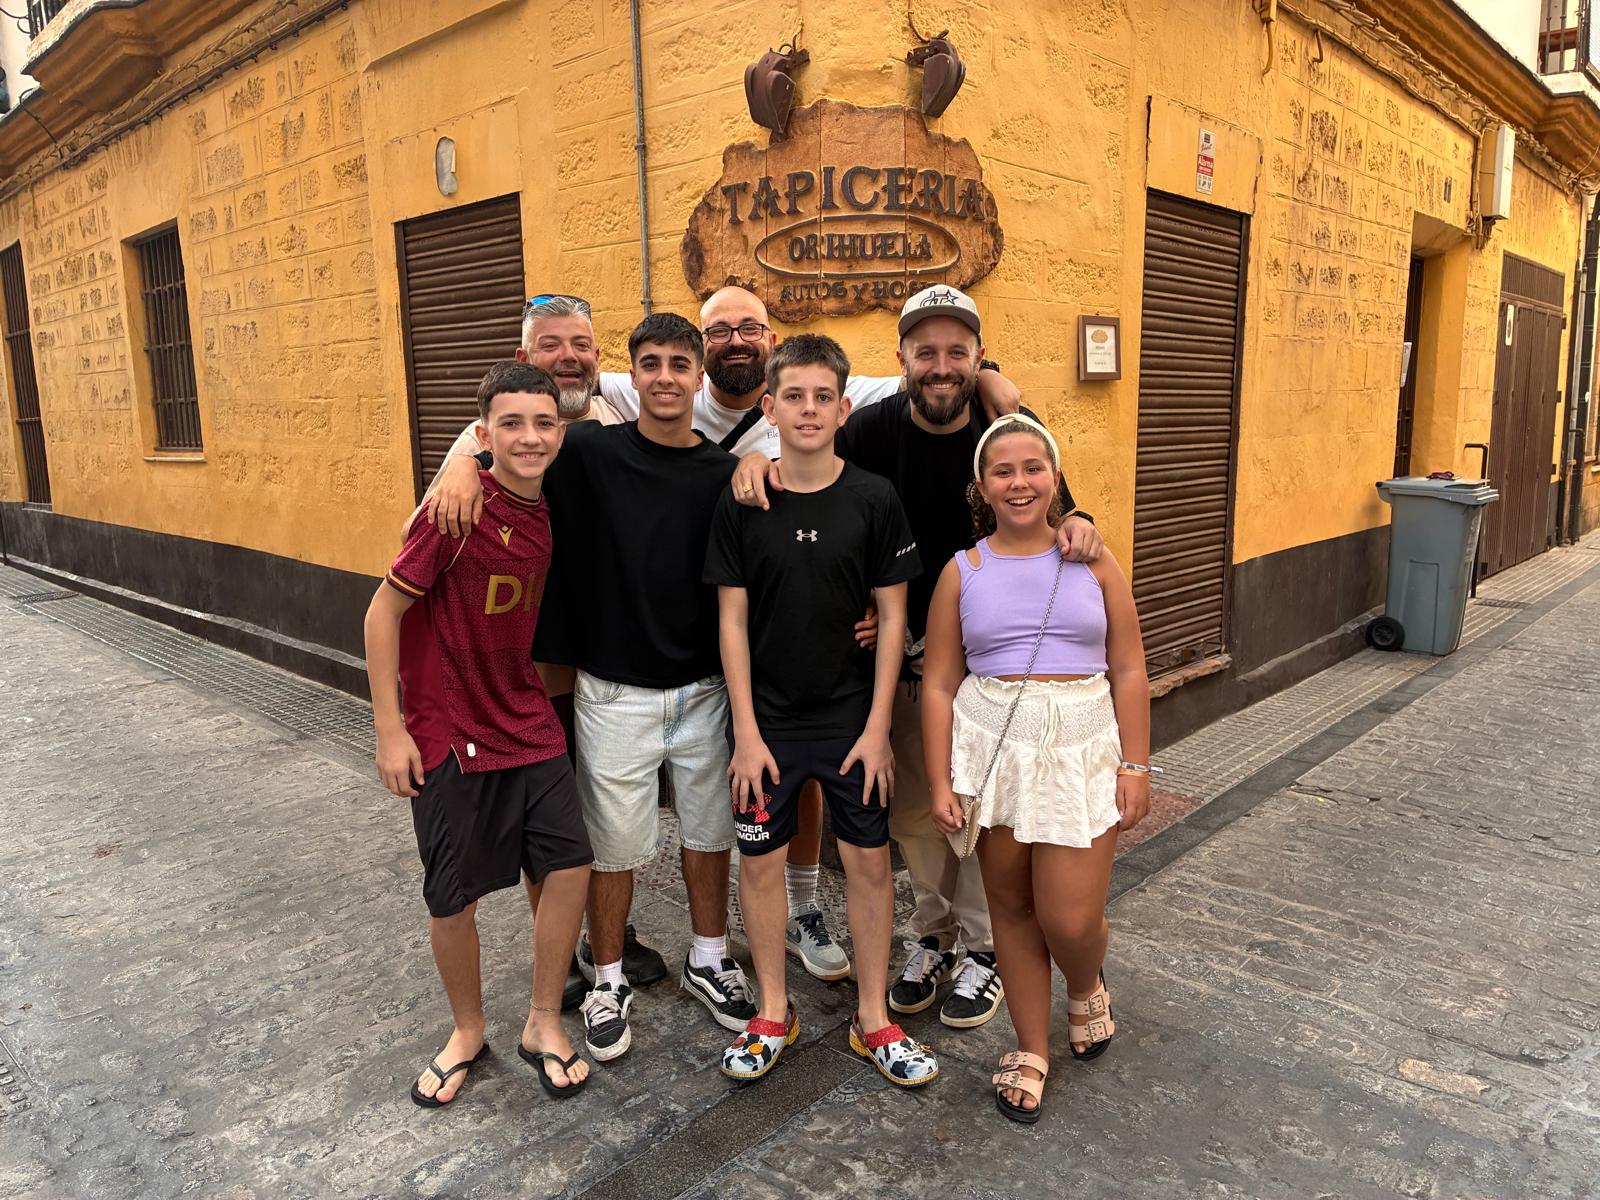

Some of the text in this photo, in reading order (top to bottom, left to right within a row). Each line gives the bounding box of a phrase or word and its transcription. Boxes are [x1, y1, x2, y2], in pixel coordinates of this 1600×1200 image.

[721, 165, 985, 224] TAPICERIA
[789, 231, 933, 261] ORIHUELA
[779, 281, 848, 304] AUTOS
